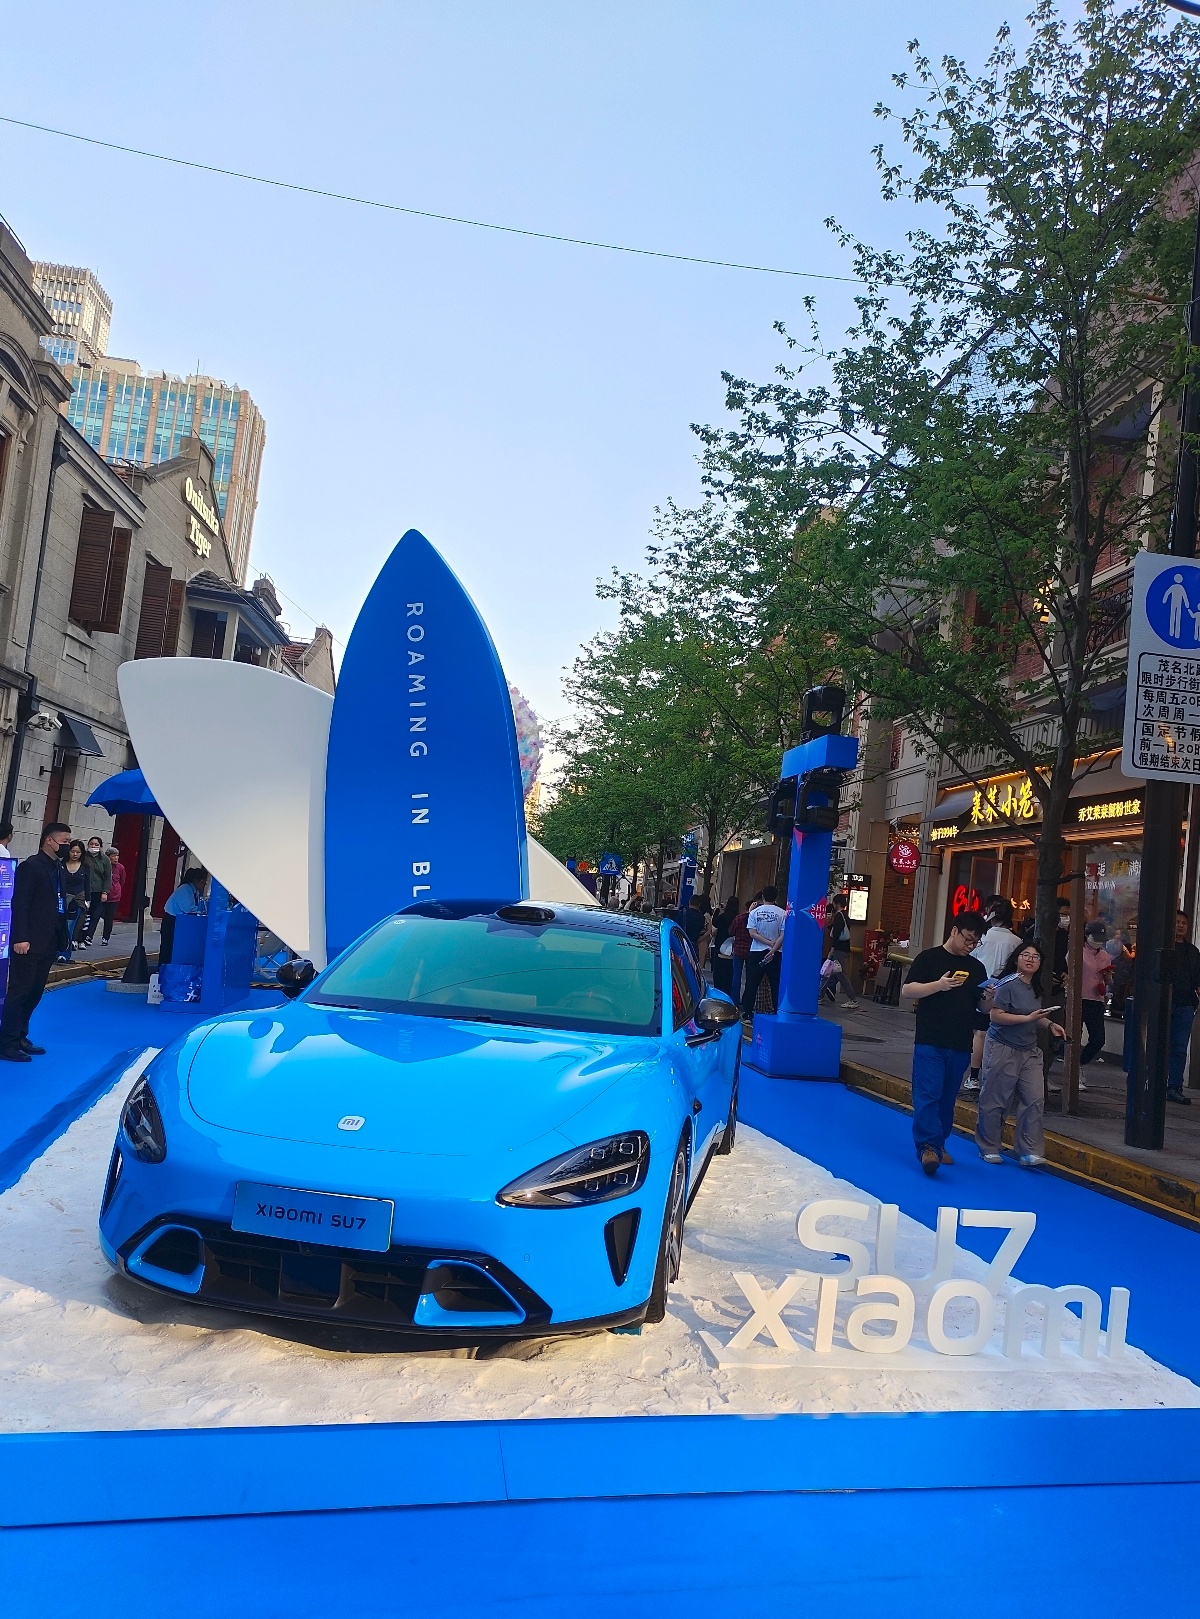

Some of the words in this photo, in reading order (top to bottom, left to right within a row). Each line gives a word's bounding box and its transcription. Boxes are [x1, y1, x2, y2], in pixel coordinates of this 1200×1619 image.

[185, 476, 220, 536] Onitsuka
[189, 514, 212, 559] Tiger
[406, 602, 428, 757] ROAMING
[1141, 671, 1200, 690] 限时步行街
[411, 793, 430, 824] IN
[330, 1214, 367, 1230] SU7
[795, 1199, 1037, 1294] SU7
